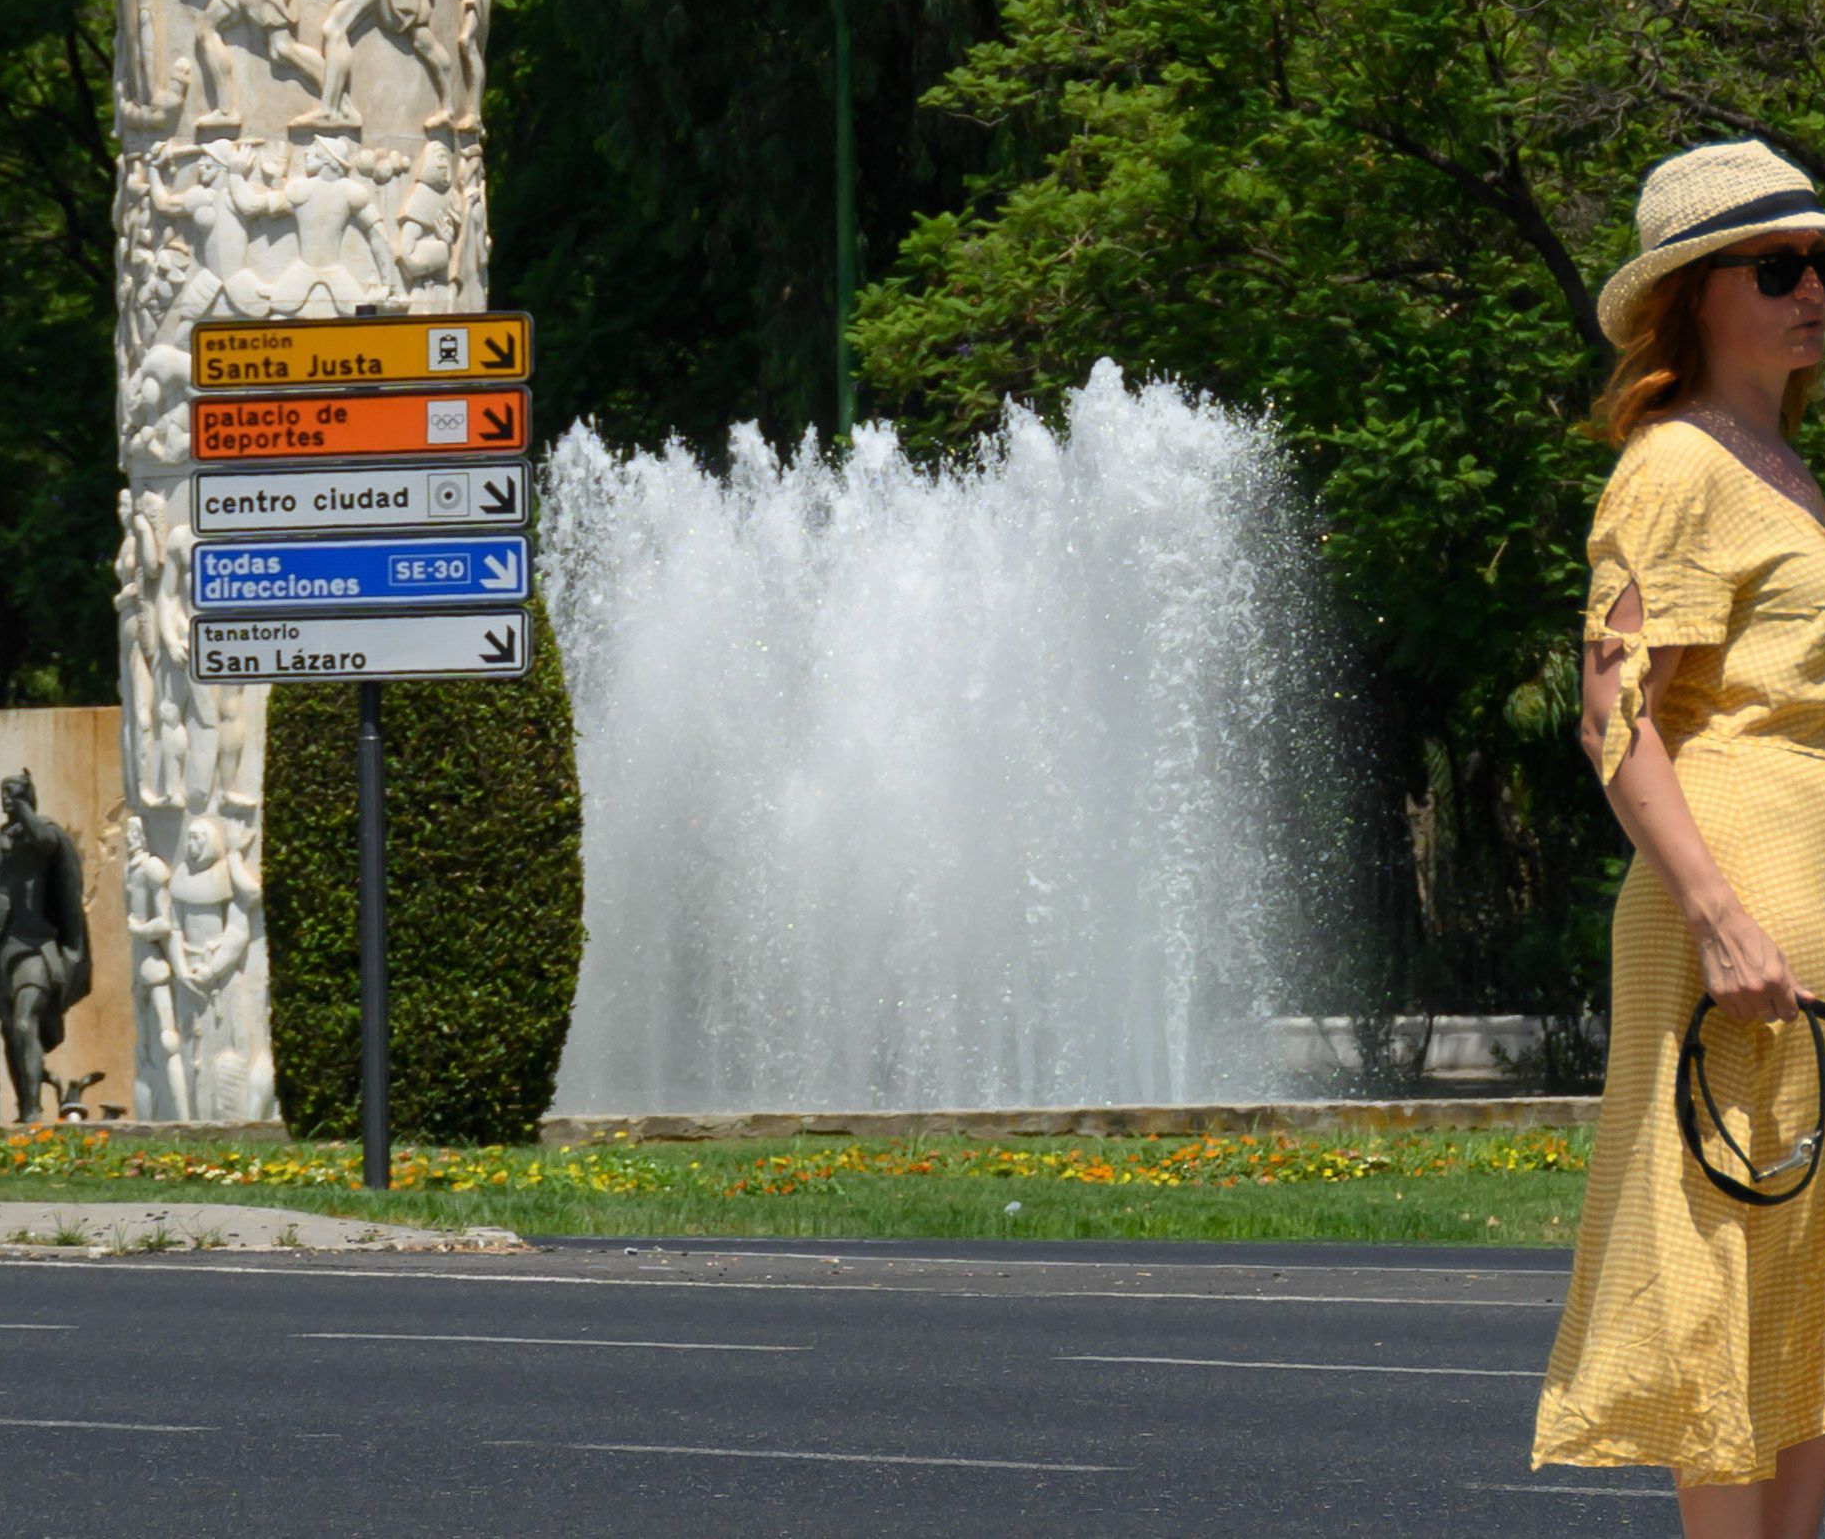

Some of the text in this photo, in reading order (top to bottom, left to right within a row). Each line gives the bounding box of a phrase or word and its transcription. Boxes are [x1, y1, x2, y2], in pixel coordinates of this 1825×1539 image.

[205, 333, 294, 352] estación
[206, 354, 383, 380] Santa Justa
[204, 404, 348, 431] palacio de
[205, 429, 325, 453] deportes
[205, 487, 409, 515] centro ciudad
[205, 553, 281, 576] todas
[396, 559, 465, 580] SE-30
[205, 574, 360, 600] direcciones
[205, 625, 300, 642] tanatorio
[206, 647, 366, 673] San Lázaro
